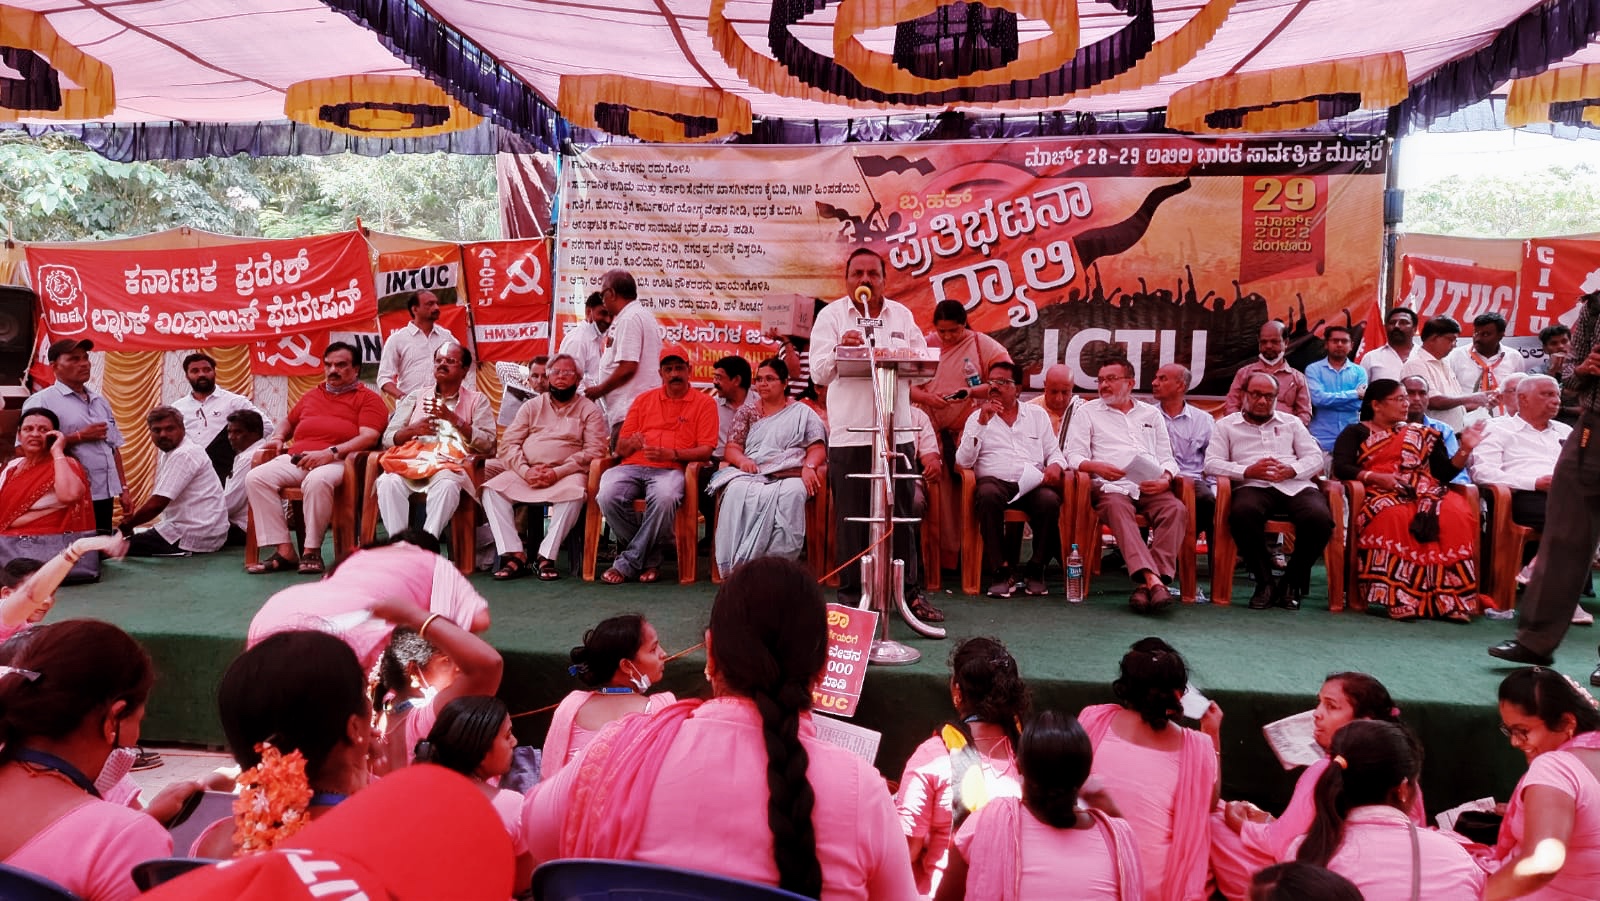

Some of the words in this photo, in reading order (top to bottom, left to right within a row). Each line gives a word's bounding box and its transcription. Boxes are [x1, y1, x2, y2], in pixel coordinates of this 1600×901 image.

[1087, 147, 1140, 165] 28-29
[1146, 148, 1193, 165] ಅಖಿಲ
[1197, 142, 1243, 169] ಭಾರತ
[1246, 141, 1323, 167] ಸಾರ್ವತ್ರಿಕ
[1325, 140, 1384, 168] ಮುಷ್ಕರ
[792, 184, 812, 195] NMP
[899, 187, 974, 220] ಬೃಹತ್
[1253, 178, 1317, 211] 29
[885, 181, 1093, 277] ಪ್ರತಿಭಟನಾ
[1255, 227, 1311, 239] 2022
[1253, 239, 1312, 252] ಬೆಂಗಳೂರು
[124, 259, 218, 295] ಕರ್ನಾಟಕ
[235, 248, 310, 296] ಪ್ರದೇಶ್
[589, 256, 604, 266] 700
[385, 265, 449, 294] INTUC
[478, 248, 497, 306] AICCTU
[1530, 246, 1555, 334] CITU
[658, 299, 676, 308] NPS
[1400, 274, 1513, 323] AITUC
[49, 307, 83, 325] AIBEA
[1030, 328, 1208, 391] JCTU
[827, 660, 854, 675] 000
[828, 645, 862, 662] ವೇತನ
[811, 691, 848, 710] TUC
